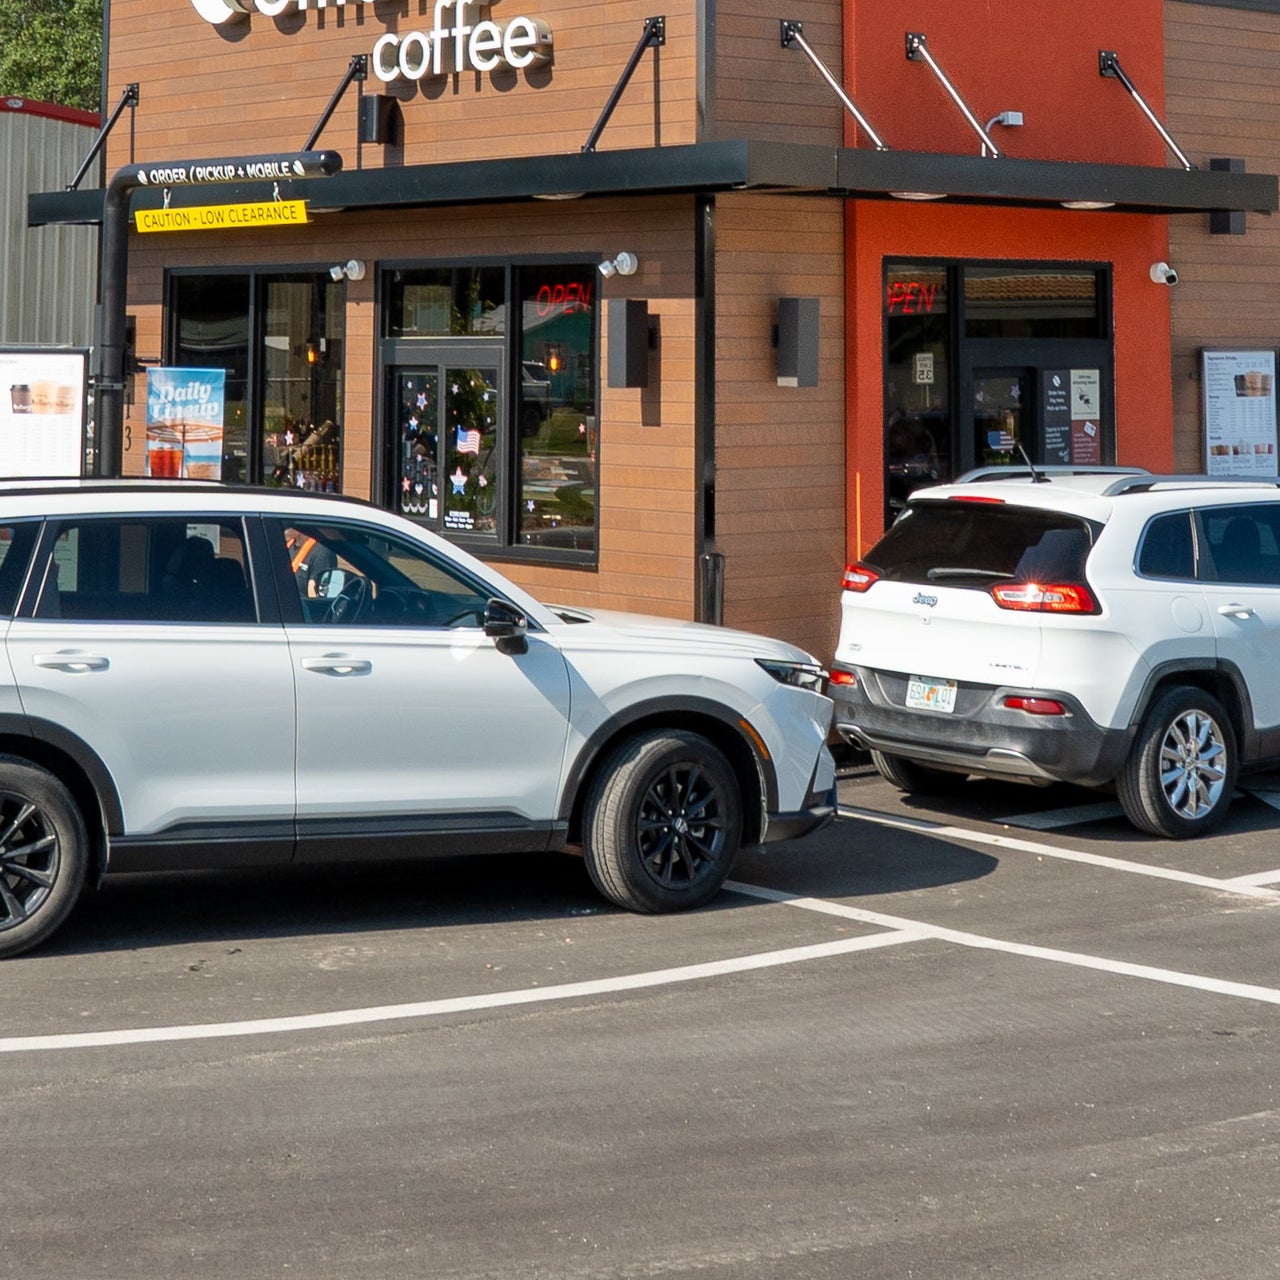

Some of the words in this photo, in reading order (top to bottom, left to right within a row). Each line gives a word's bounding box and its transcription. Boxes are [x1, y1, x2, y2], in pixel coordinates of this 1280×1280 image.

[149, 167, 188, 184] ORDER
[196, 165, 236, 182] PICKUP
[246, 161, 293, 178] MOBILE
[143, 212, 191, 228] CAUTION
[200, 210, 224, 225] LOW
[228, 205, 298, 223] CLEARANCE
[536, 282, 592, 317] OPEN
[158, 380, 211, 404] Daily
[152, 401, 219, 420] Lineup
[912, 592, 938, 608] Jeep
